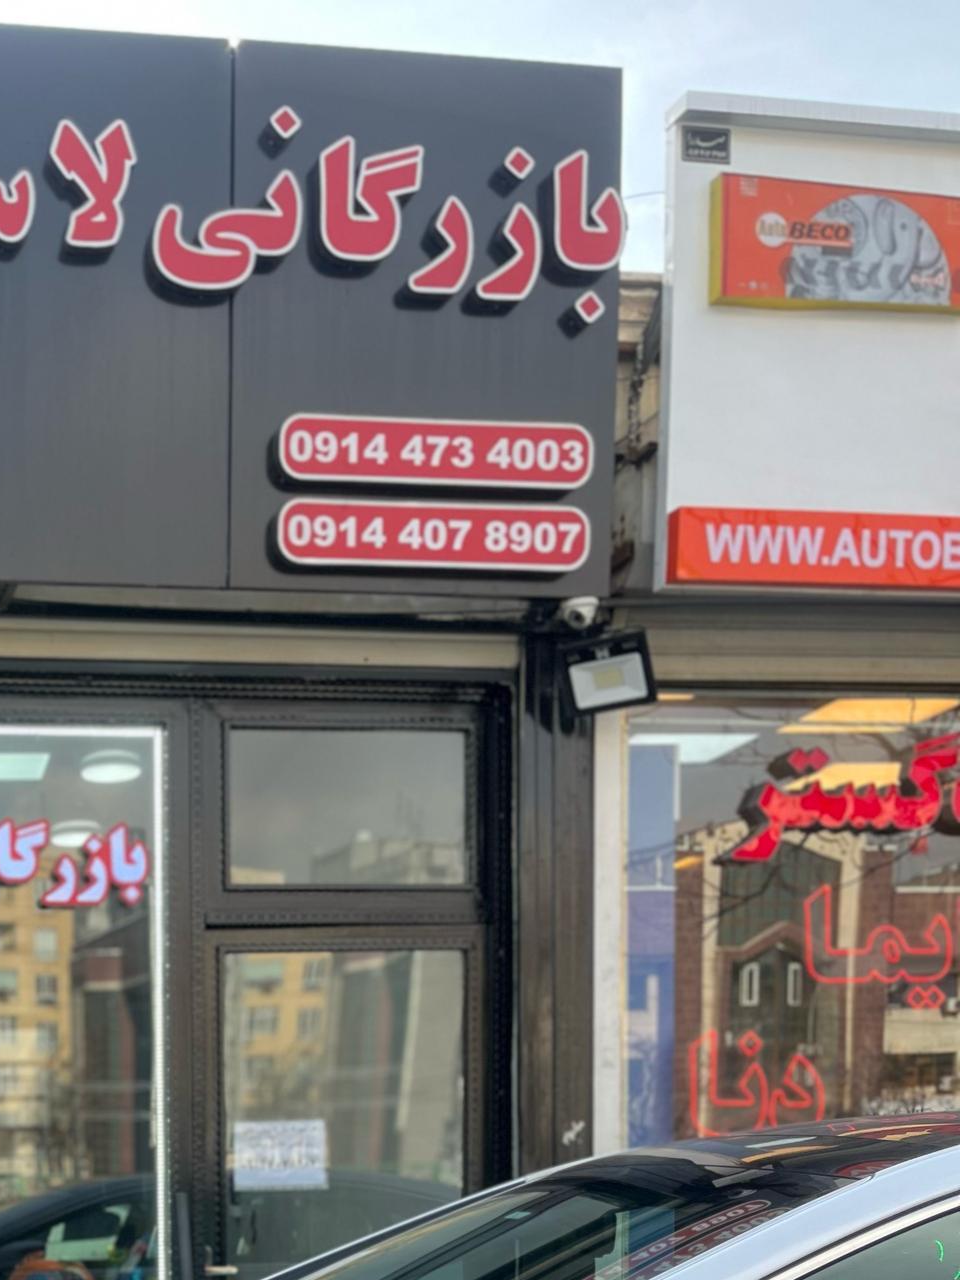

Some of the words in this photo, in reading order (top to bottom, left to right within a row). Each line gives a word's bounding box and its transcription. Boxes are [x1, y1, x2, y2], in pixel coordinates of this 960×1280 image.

[154, 105, 626, 324] بازرگانی
[790, 221, 851, 240] BECO
[289, 430, 389, 465] 0914
[400, 434, 474, 468] 473
[486, 437, 585, 472] 4003
[287, 515, 386, 548] 0914
[398, 518, 472, 550] 407
[484, 521, 581, 554] 8907
